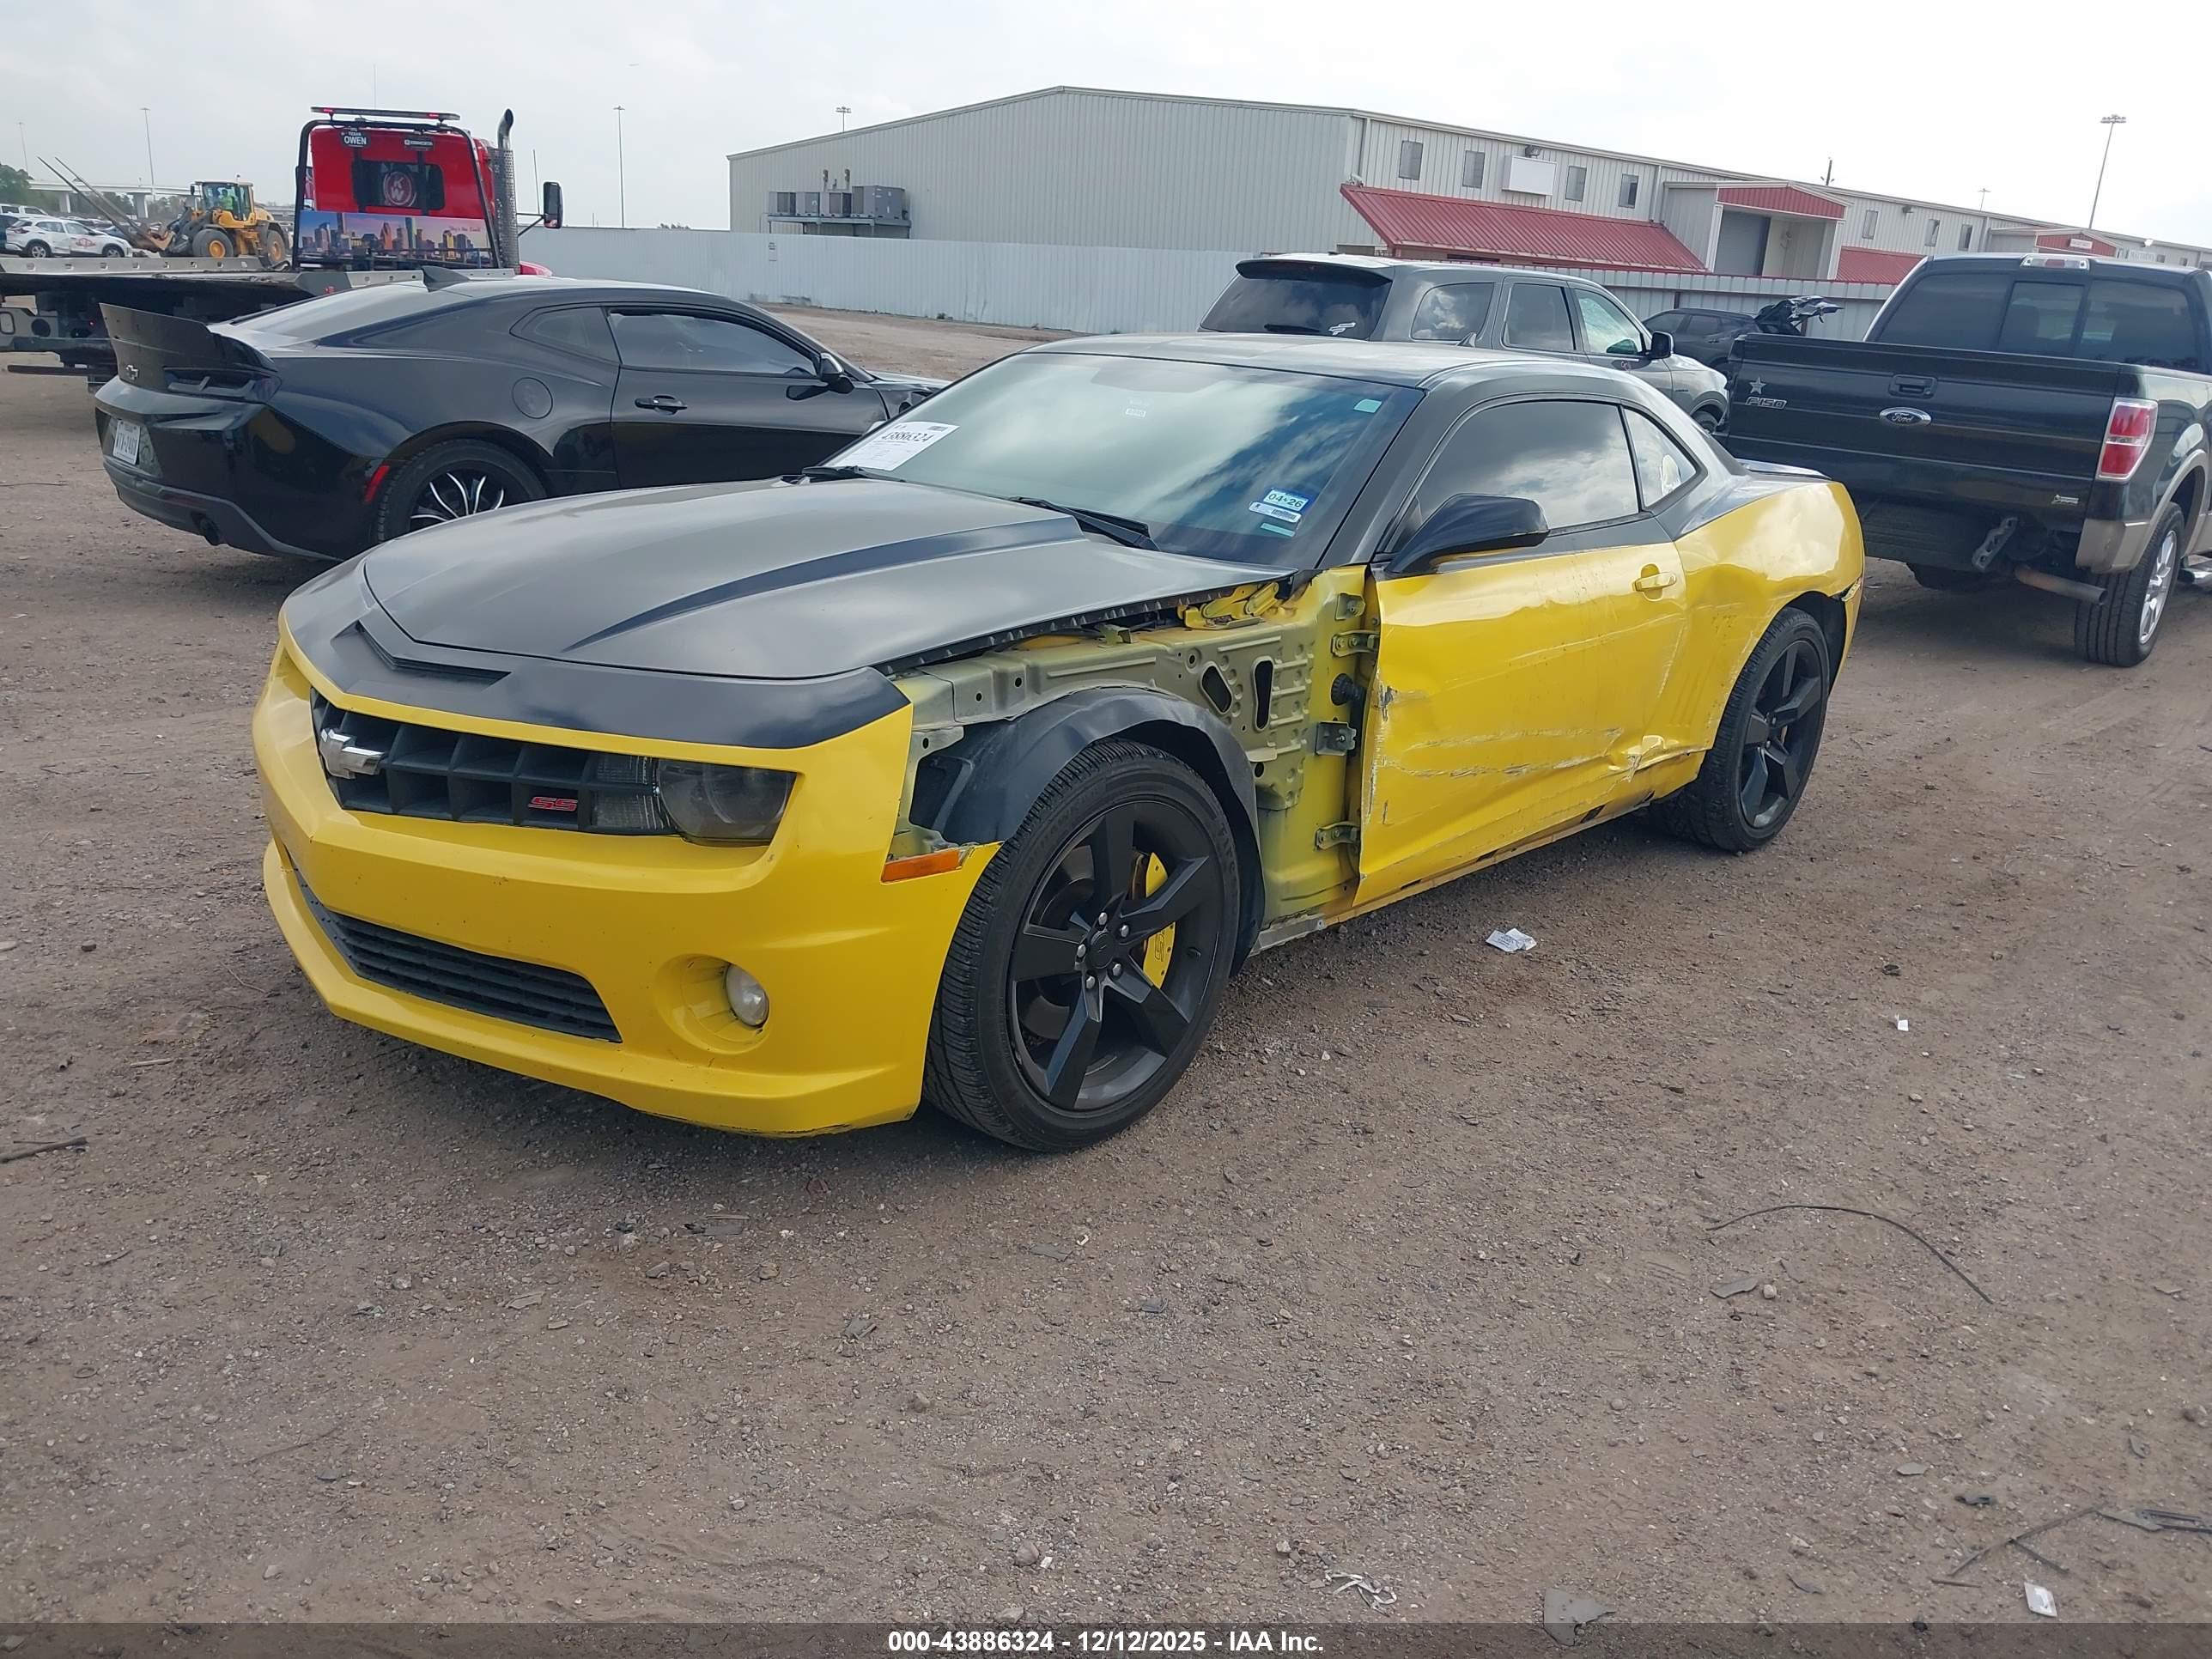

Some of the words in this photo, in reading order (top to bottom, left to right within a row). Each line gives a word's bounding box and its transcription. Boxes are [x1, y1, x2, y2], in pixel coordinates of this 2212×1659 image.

[343, 136, 367, 145] OWEN
[1892, 412, 1915, 422] Ford
[1268, 493, 1284, 502] 04
[1287, 498, 1304, 507] 26
[528, 796, 579, 811] SS
